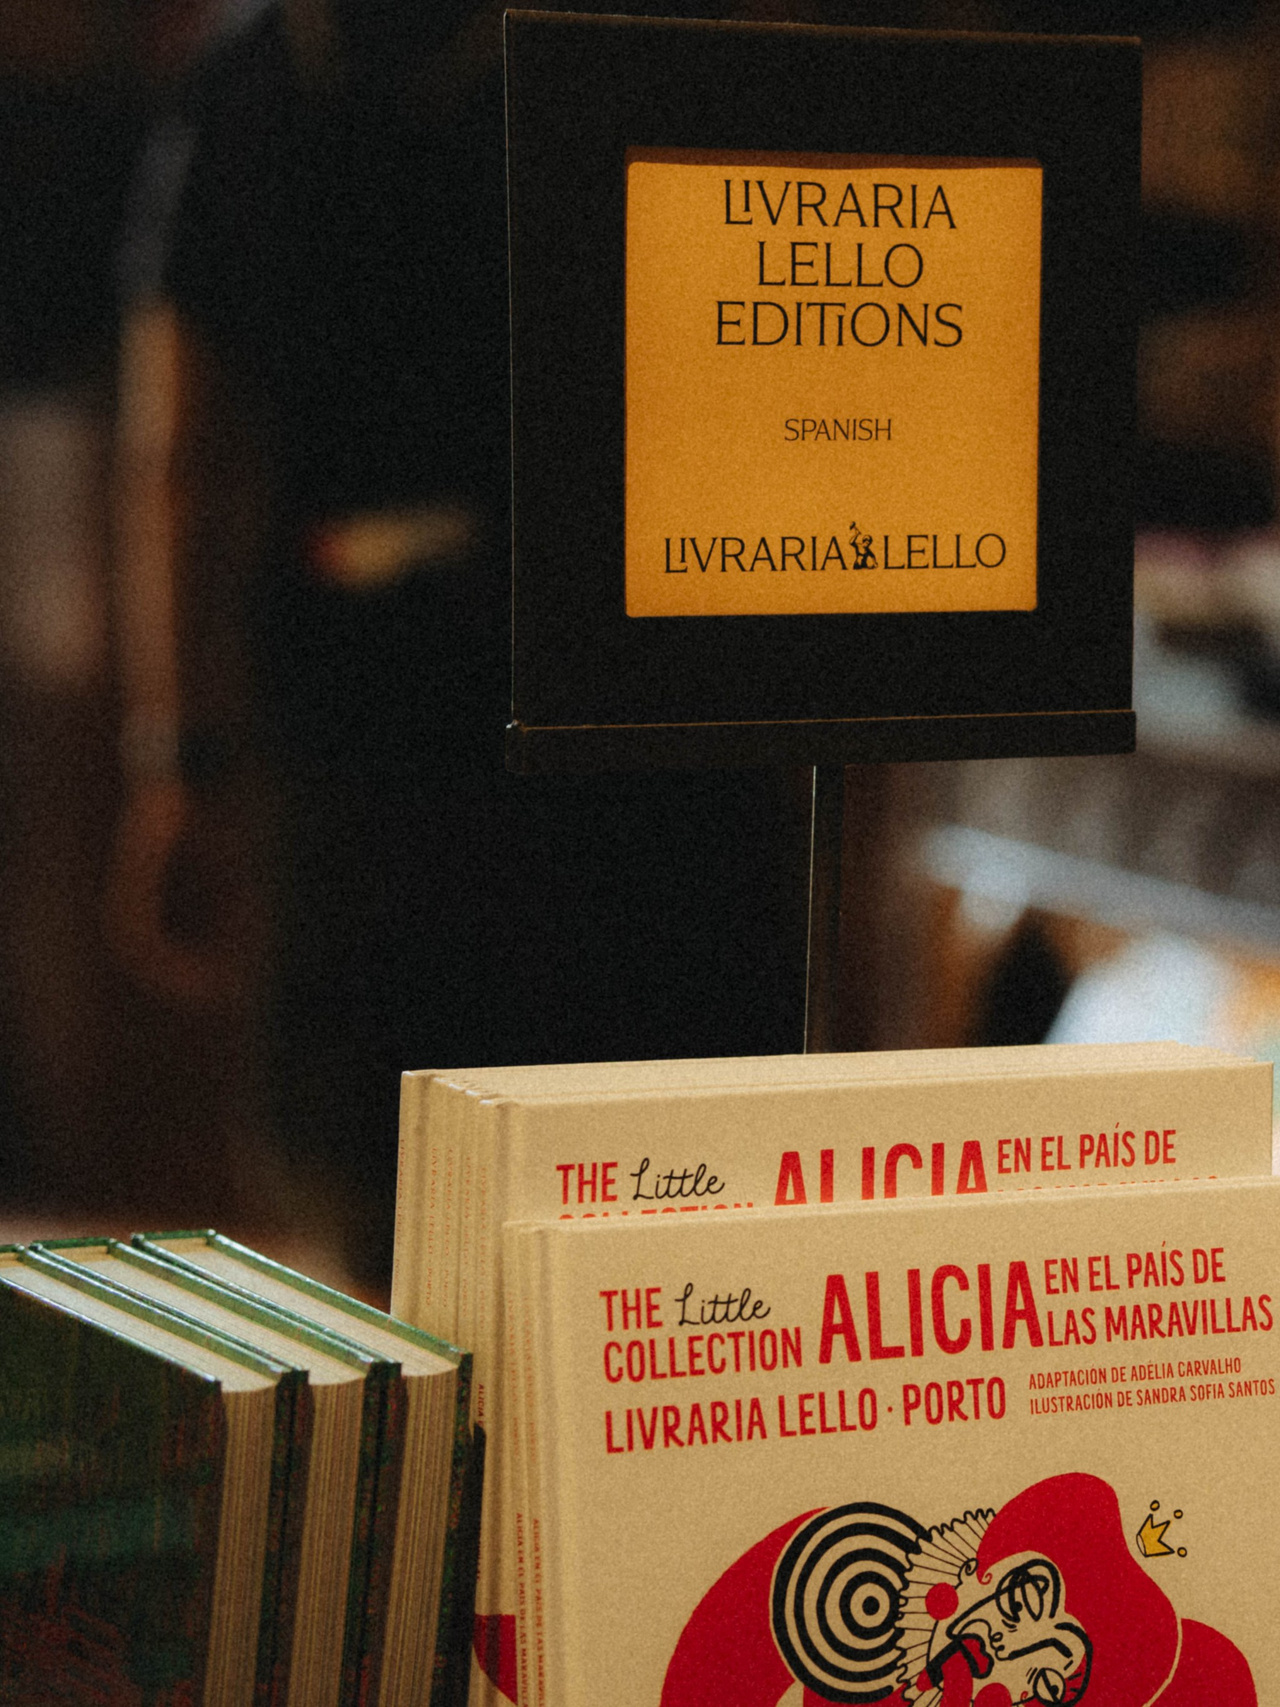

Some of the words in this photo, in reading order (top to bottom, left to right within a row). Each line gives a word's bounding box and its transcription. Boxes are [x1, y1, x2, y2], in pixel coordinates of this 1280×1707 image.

[723, 179, 957, 229] LIVRARIA
[758, 240, 924, 288] LELLO
[716, 300, 964, 347] EDITIONS
[783, 418, 893, 441] SPANISH
[664, 536, 848, 573] LIVRARIA
[883, 533, 1007, 571] LELLO
[998, 1137, 1031, 1174] EN
[1040, 1135, 1071, 1172] EL
[1079, 1122, 1136, 1169] PAÍS
[1144, 1129, 1177, 1165] DE
[556, 1161, 618, 1205] THE
[629, 1157, 725, 1200] Little
[1044, 1257, 1080, 1295] EN
[1088, 1255, 1120, 1292] EL
[1126, 1240, 1185, 1288] PAÍS
[1192, 1247, 1226, 1284] DE
[600, 1287, 663, 1332] THE
[674, 1282, 771, 1326] Little
[819, 1260, 1044, 1364] ALICIA
[1047, 1307, 1097, 1347] LAS
[1104, 1294, 1274, 1343] MARAVILLAS
[604, 1326, 802, 1383] COLLECTION
[1029, 1363, 1107, 1390] ADAPTACIÓN
[1111, 1366, 1127, 1383] DE
[1178, 1357, 1241, 1378] CARVALHO
[605, 1397, 768, 1454] LIVRARIA
[778, 1388, 878, 1438] LELLO
[902, 1377, 1006, 1426] PORTO
[1030, 1388, 1113, 1415] ILUSTRACIÓN
[1117, 1391, 1133, 1407] DE
[1136, 1386, 1186, 1407] SANDRA
[1190, 1382, 1225, 1402] SOFIA
[1228, 1378, 1275, 1399] SANTOS
